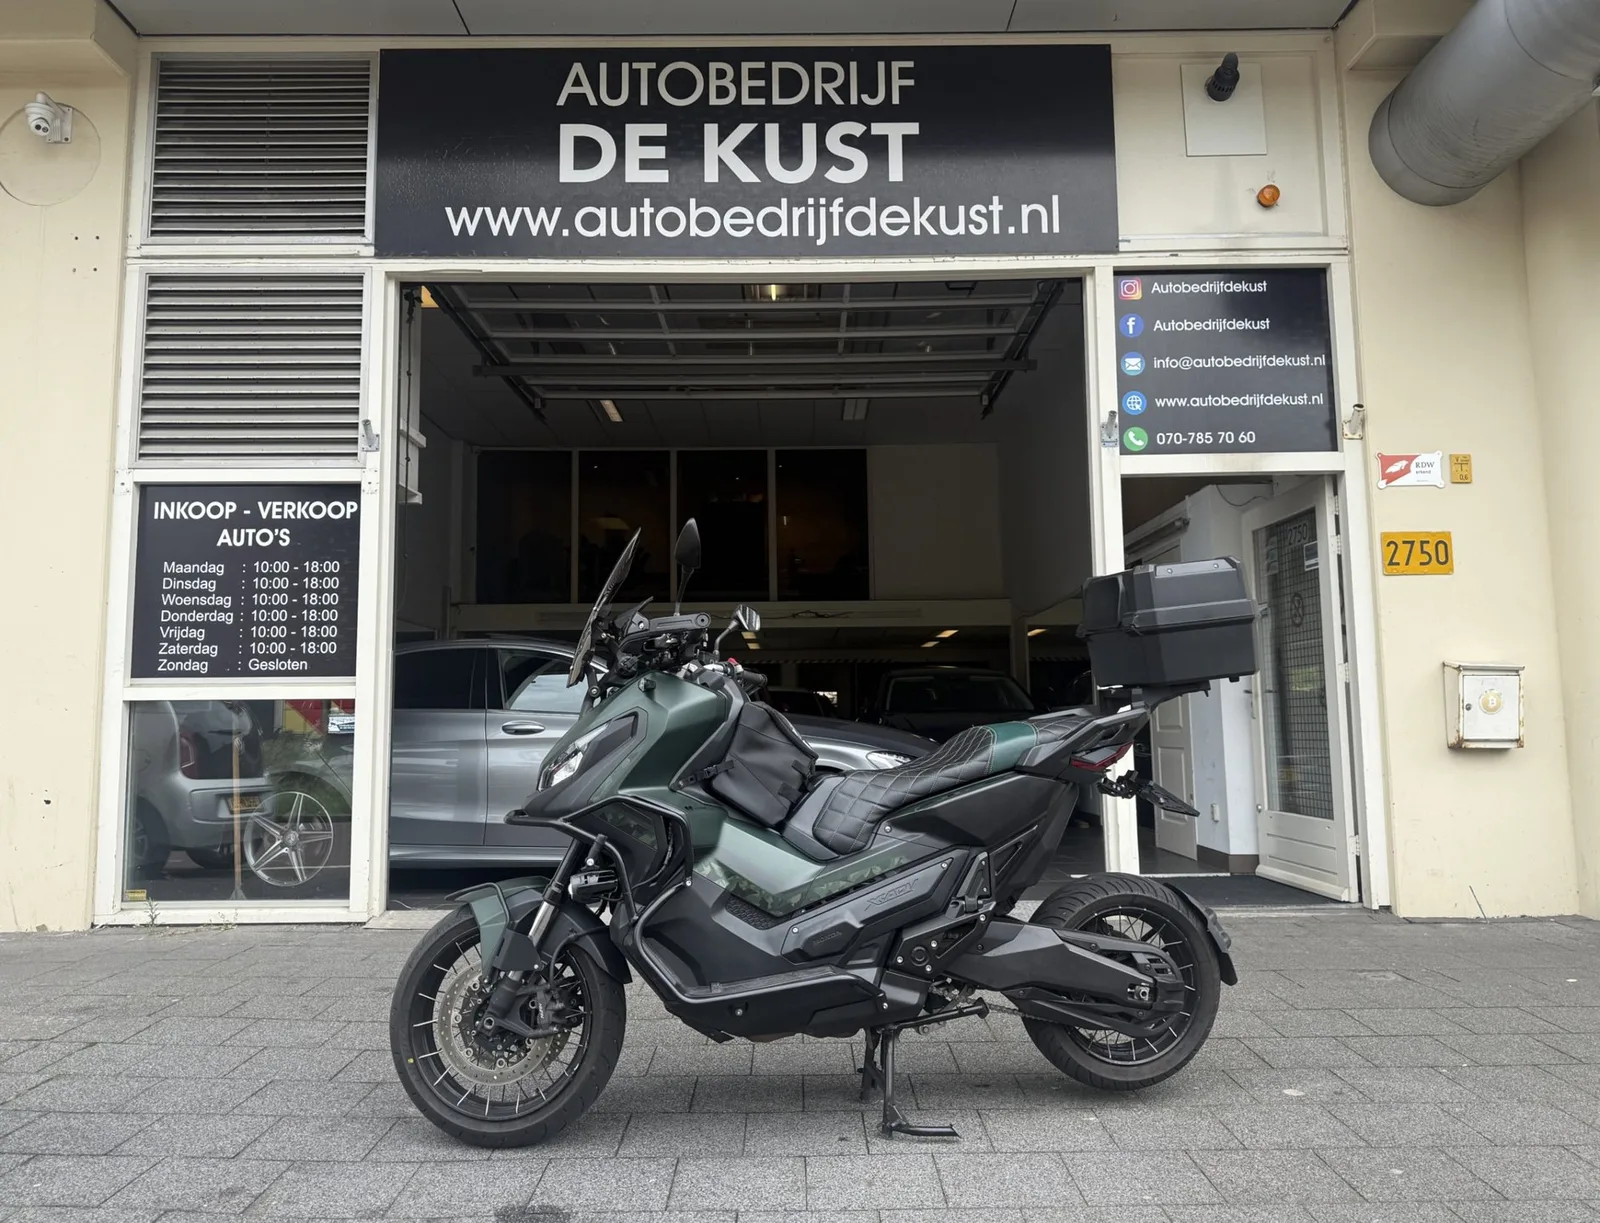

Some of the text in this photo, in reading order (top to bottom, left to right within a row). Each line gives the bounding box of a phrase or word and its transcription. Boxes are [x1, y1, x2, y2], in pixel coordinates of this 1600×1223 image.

[556, 61, 915, 107] AUTOBEDRIJF
[558, 121, 920, 185] DE KUST
[444, 195, 1062, 246] www.autobedrijfdekust.nl
[1150, 280, 1267, 295] Autobedrijfdekust
[1153, 318, 1270, 333] Autobedrijfdekust
[1153, 354, 1326, 370] info@autobedrijfdekust.nl
[1154, 393, 1324, 408] www.autobedrijfdekust.nl
[1156, 431, 1256, 445] 070-785 70 60
[1415, 461, 1435, 469] RDW
[153, 500, 238, 520] INKOOP
[257, 500, 358, 520] VERKOOP
[216, 528, 291, 547] AUTO'S
[1386, 539, 1449, 566] 2750
[163, 561, 225, 576] Maandag
[253, 560, 290, 573] 10:00
[303, 560, 340, 573] 18:00
[162, 577, 216, 592] Dinsdag
[252, 576, 289, 589] 10:00
[302, 576, 339, 589] 18:00
[161, 593, 232, 608] Woensdag
[252, 593, 289, 606] 10:00
[302, 593, 339, 606] 18:00
[160, 610, 234, 624] Donderdag
[251, 609, 288, 622] 10:00
[301, 609, 338, 622] 18:00
[159, 626, 206, 641] Vrijdag
[250, 625, 287, 638] 10:00
[300, 625, 337, 638] 18:00
[158, 642, 218, 657] Zaterdag
[250, 641, 287, 654] 10:00
[300, 641, 337, 654] 18:00
[157, 658, 208, 673] Zondag
[248, 658, 308, 671] Gesloten
